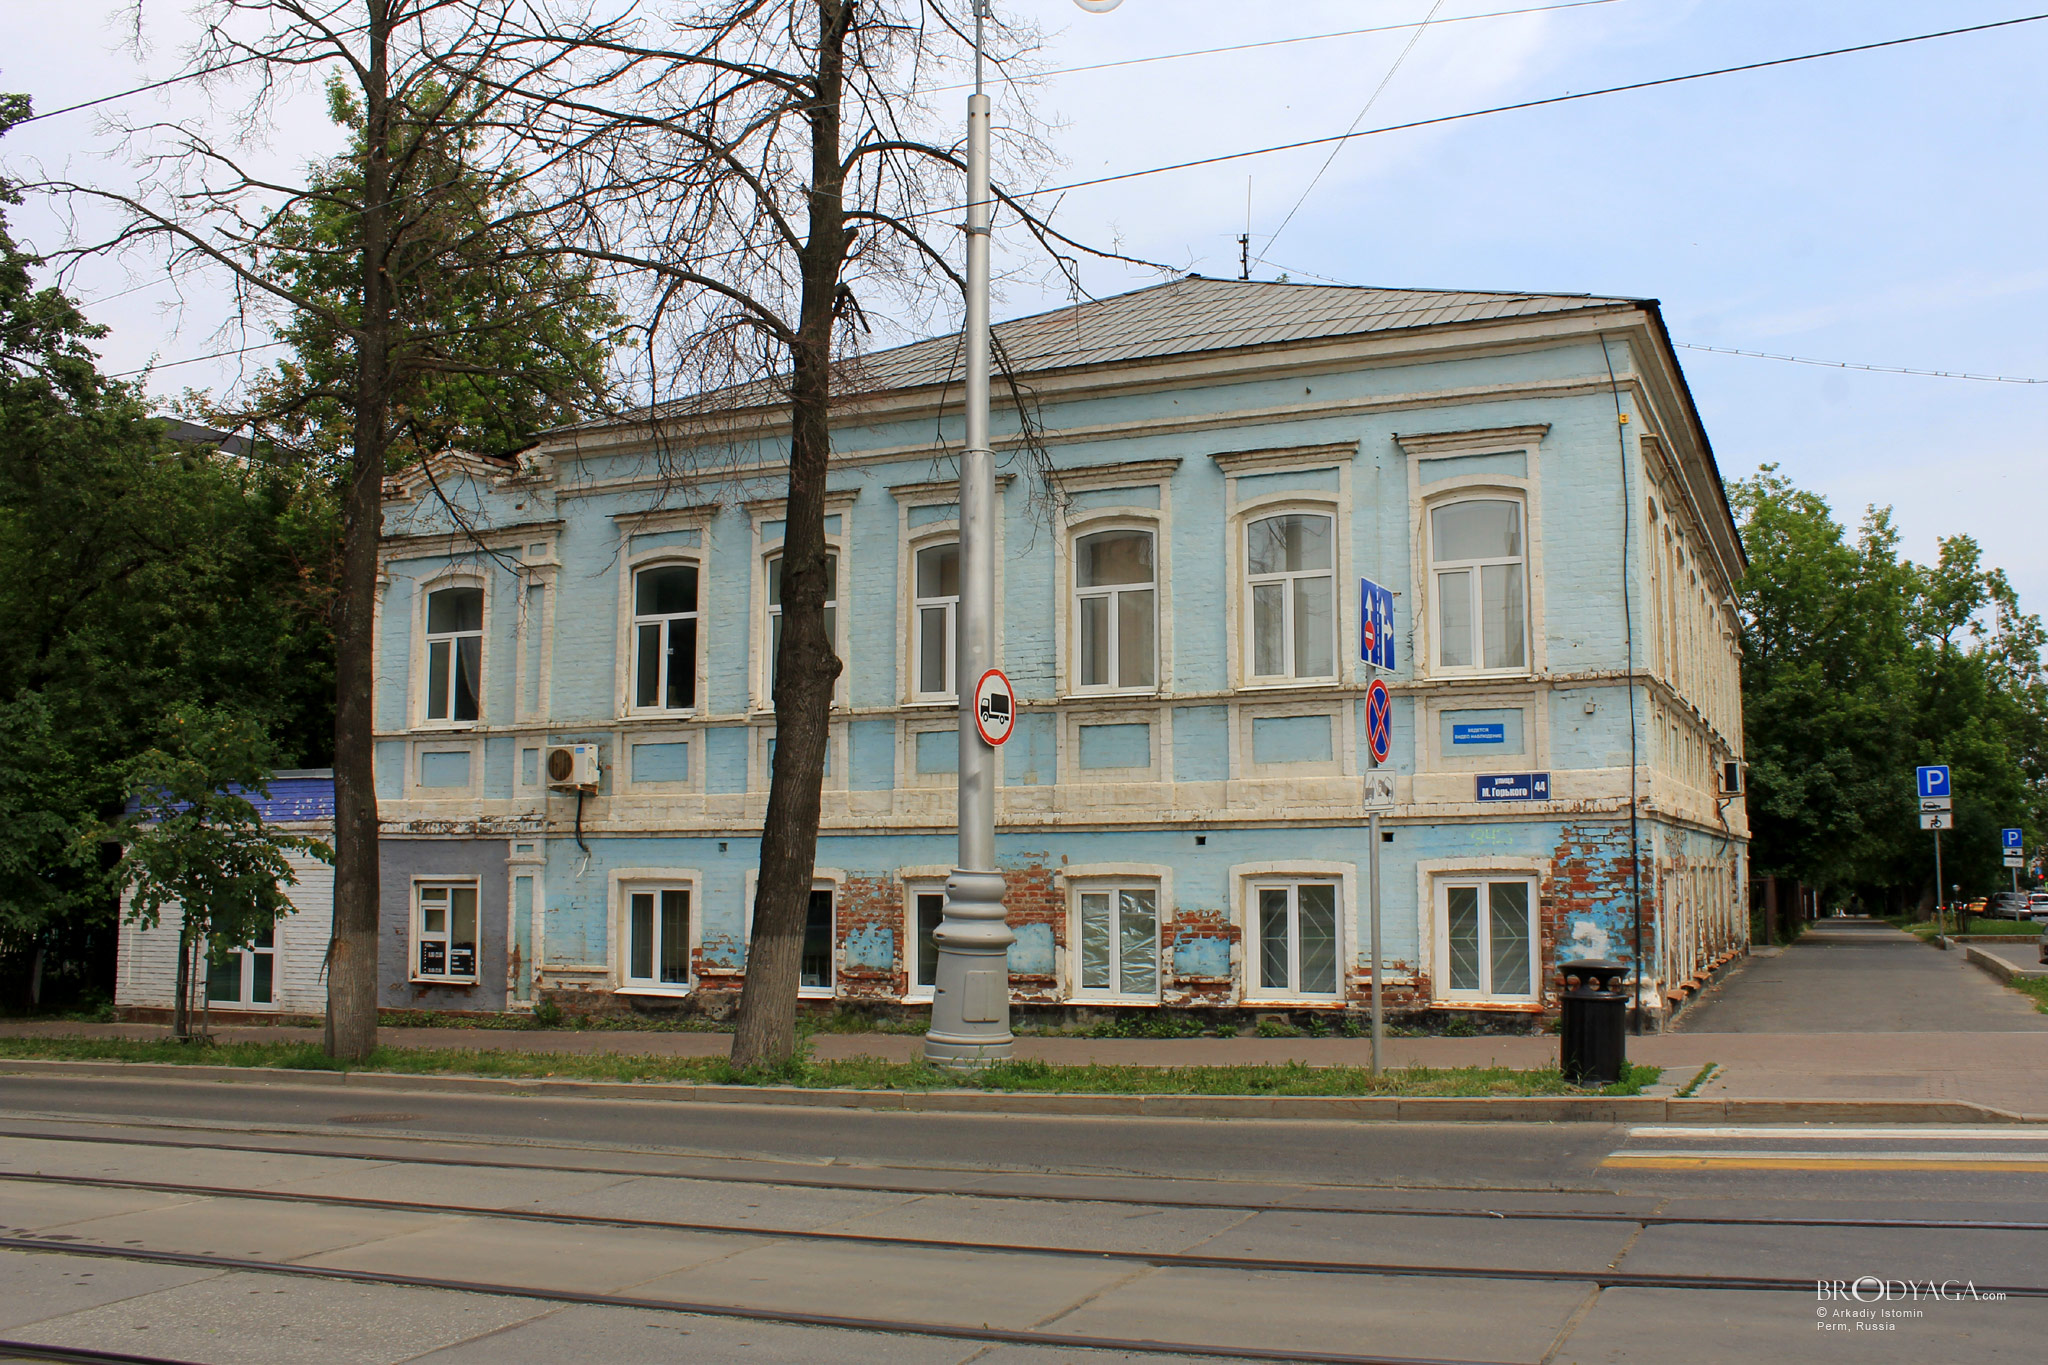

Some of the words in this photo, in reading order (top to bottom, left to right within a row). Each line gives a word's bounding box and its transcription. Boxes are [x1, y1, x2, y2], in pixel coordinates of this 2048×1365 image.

[1494, 777, 1514, 786] улица
[1534, 781, 1546, 792] 44
[1926, 769, 1944, 794] P
[1481, 787, 1491, 798] М.
[1491, 787, 1528, 798] Горького
[2008, 831, 2019, 846] P
